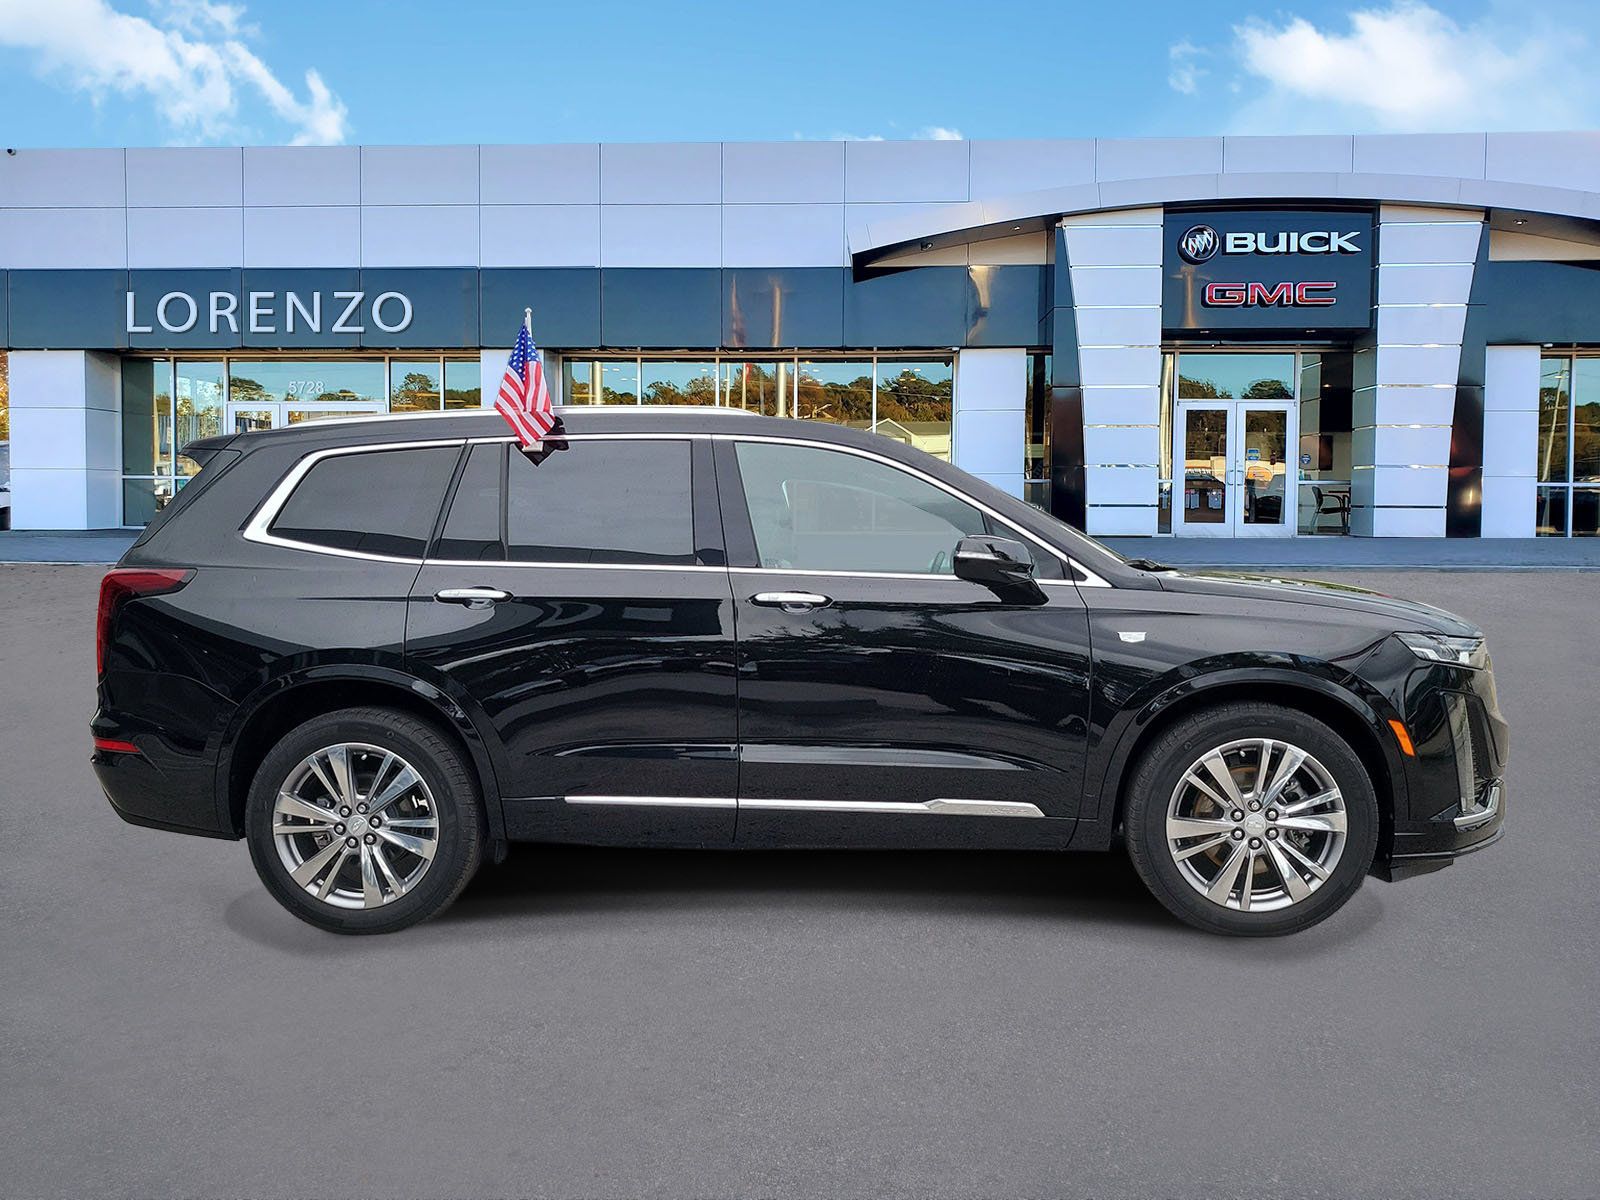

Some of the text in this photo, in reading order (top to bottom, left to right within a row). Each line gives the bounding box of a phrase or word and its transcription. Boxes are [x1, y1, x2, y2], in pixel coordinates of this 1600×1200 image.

[1225, 231, 1362, 253] BUICK
[1206, 282, 1337, 305] GMC
[125, 291, 413, 333] LORENZO
[288, 381, 325, 394] 5728
